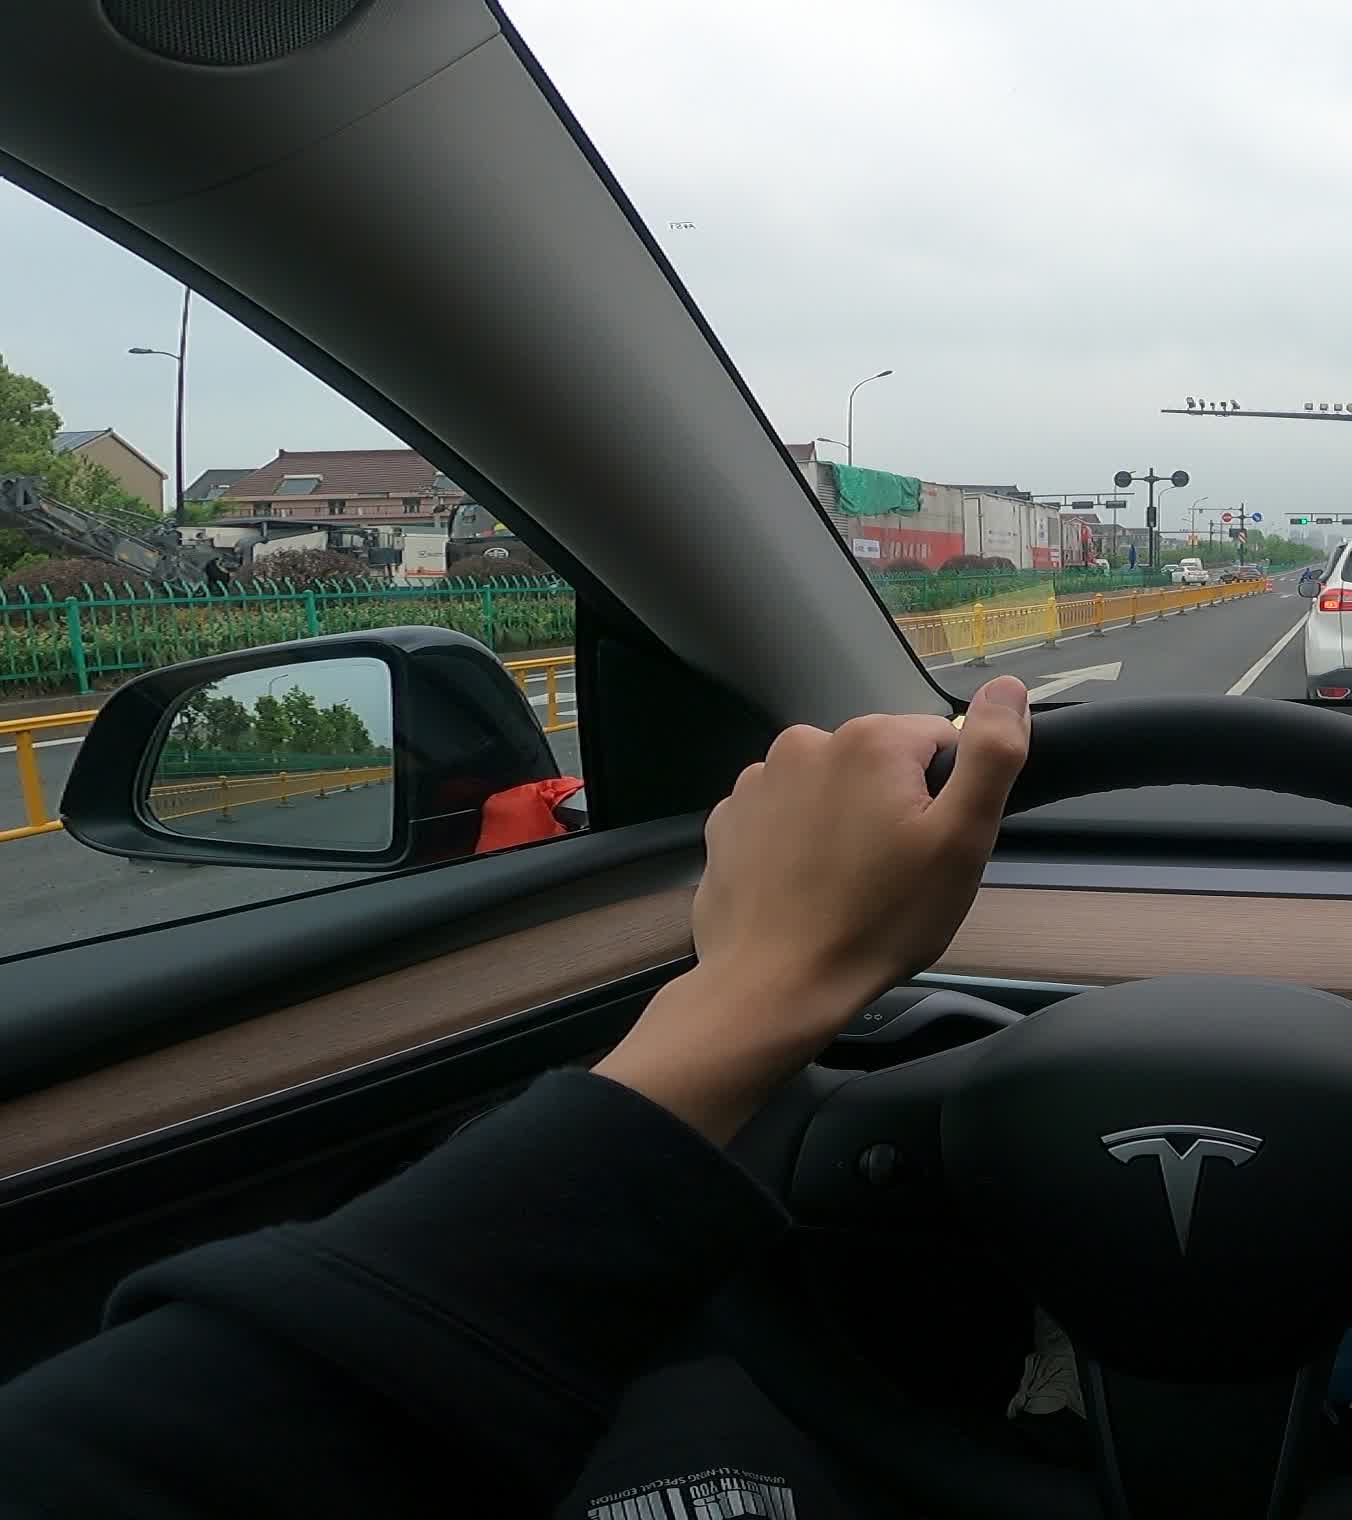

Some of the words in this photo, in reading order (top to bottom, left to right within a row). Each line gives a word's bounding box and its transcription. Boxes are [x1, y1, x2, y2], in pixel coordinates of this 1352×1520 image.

[639, 1475, 687, 1492] SPECIAL
[689, 1480, 719, 1499] YOU
[590, 1487, 637, 1506] EDITION
